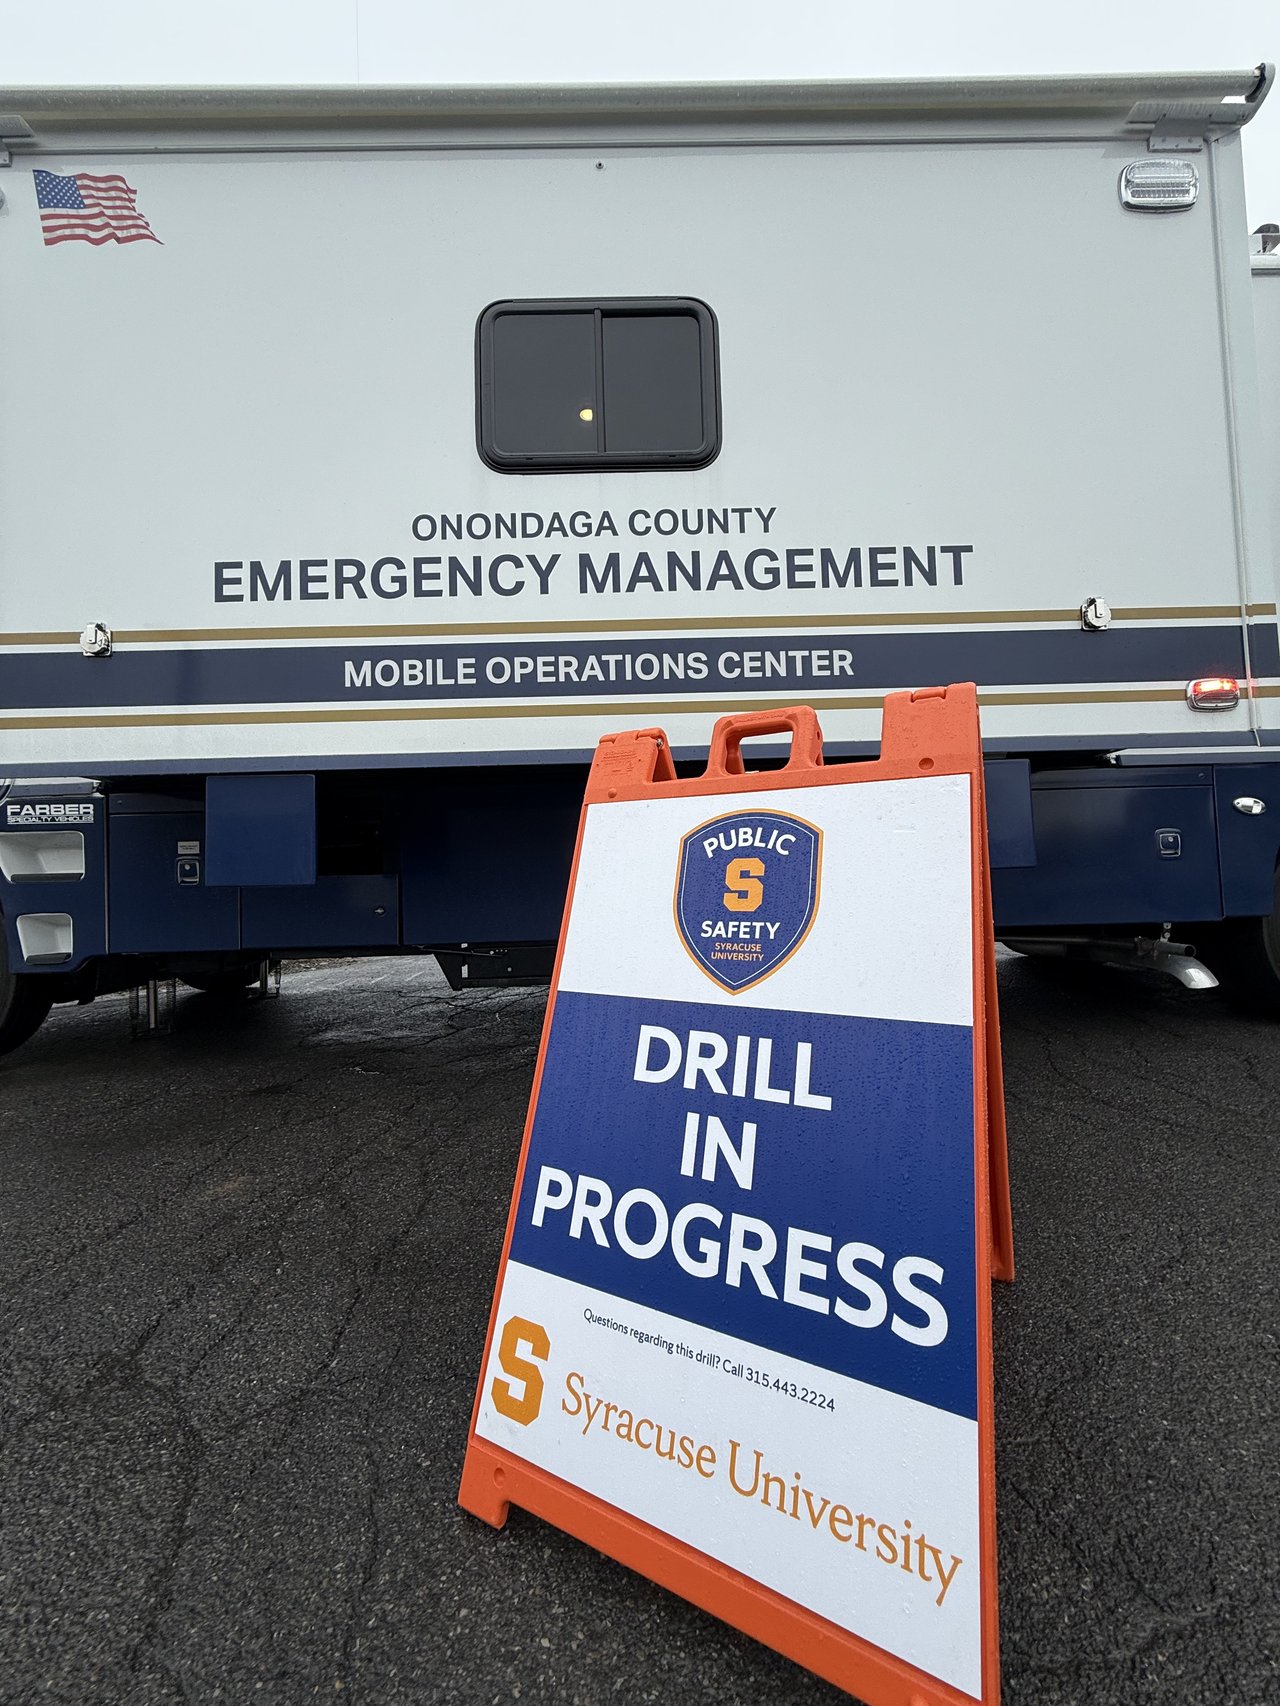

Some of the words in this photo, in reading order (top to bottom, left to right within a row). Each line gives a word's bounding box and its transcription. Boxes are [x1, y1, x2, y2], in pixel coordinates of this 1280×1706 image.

[411, 511, 617, 541] ONONDAGA
[628, 507, 777, 536] COUNTY
[214, 553, 561, 602] EMERGENCY
[579, 545, 973, 594] MANAGEMENT
[344, 658, 476, 687] MOBILE
[485, 651, 709, 685] OPERATIONS
[717, 649, 854, 678] CENTER
[7, 804, 94, 815] FARBER
[702, 827, 796, 858] PUBLIC
[723, 857, 765, 912] S
[700, 920, 781, 940] SAFETY
[711, 952, 764, 962] UNIVERSITY
[715, 942, 762, 952] SYRACUSE
[633, 1024, 832, 1110] DRILL
[680, 1112, 757, 1191] IN
[531, 1165, 949, 1348] PROGRESS
[490, 1315, 551, 1427] S
[583, 1308, 628, 1335] Questions
[629, 1327, 674, 1355] regarding
[675, 1342, 694, 1360] this
[695, 1349, 721, 1369] drill?
[722, 1359, 744, 1379] Call
[745, 1367, 836, 1413] 315.443.2224
[561, 1371, 717, 1479] Syracuse
[728, 1440, 963, 1606] University
